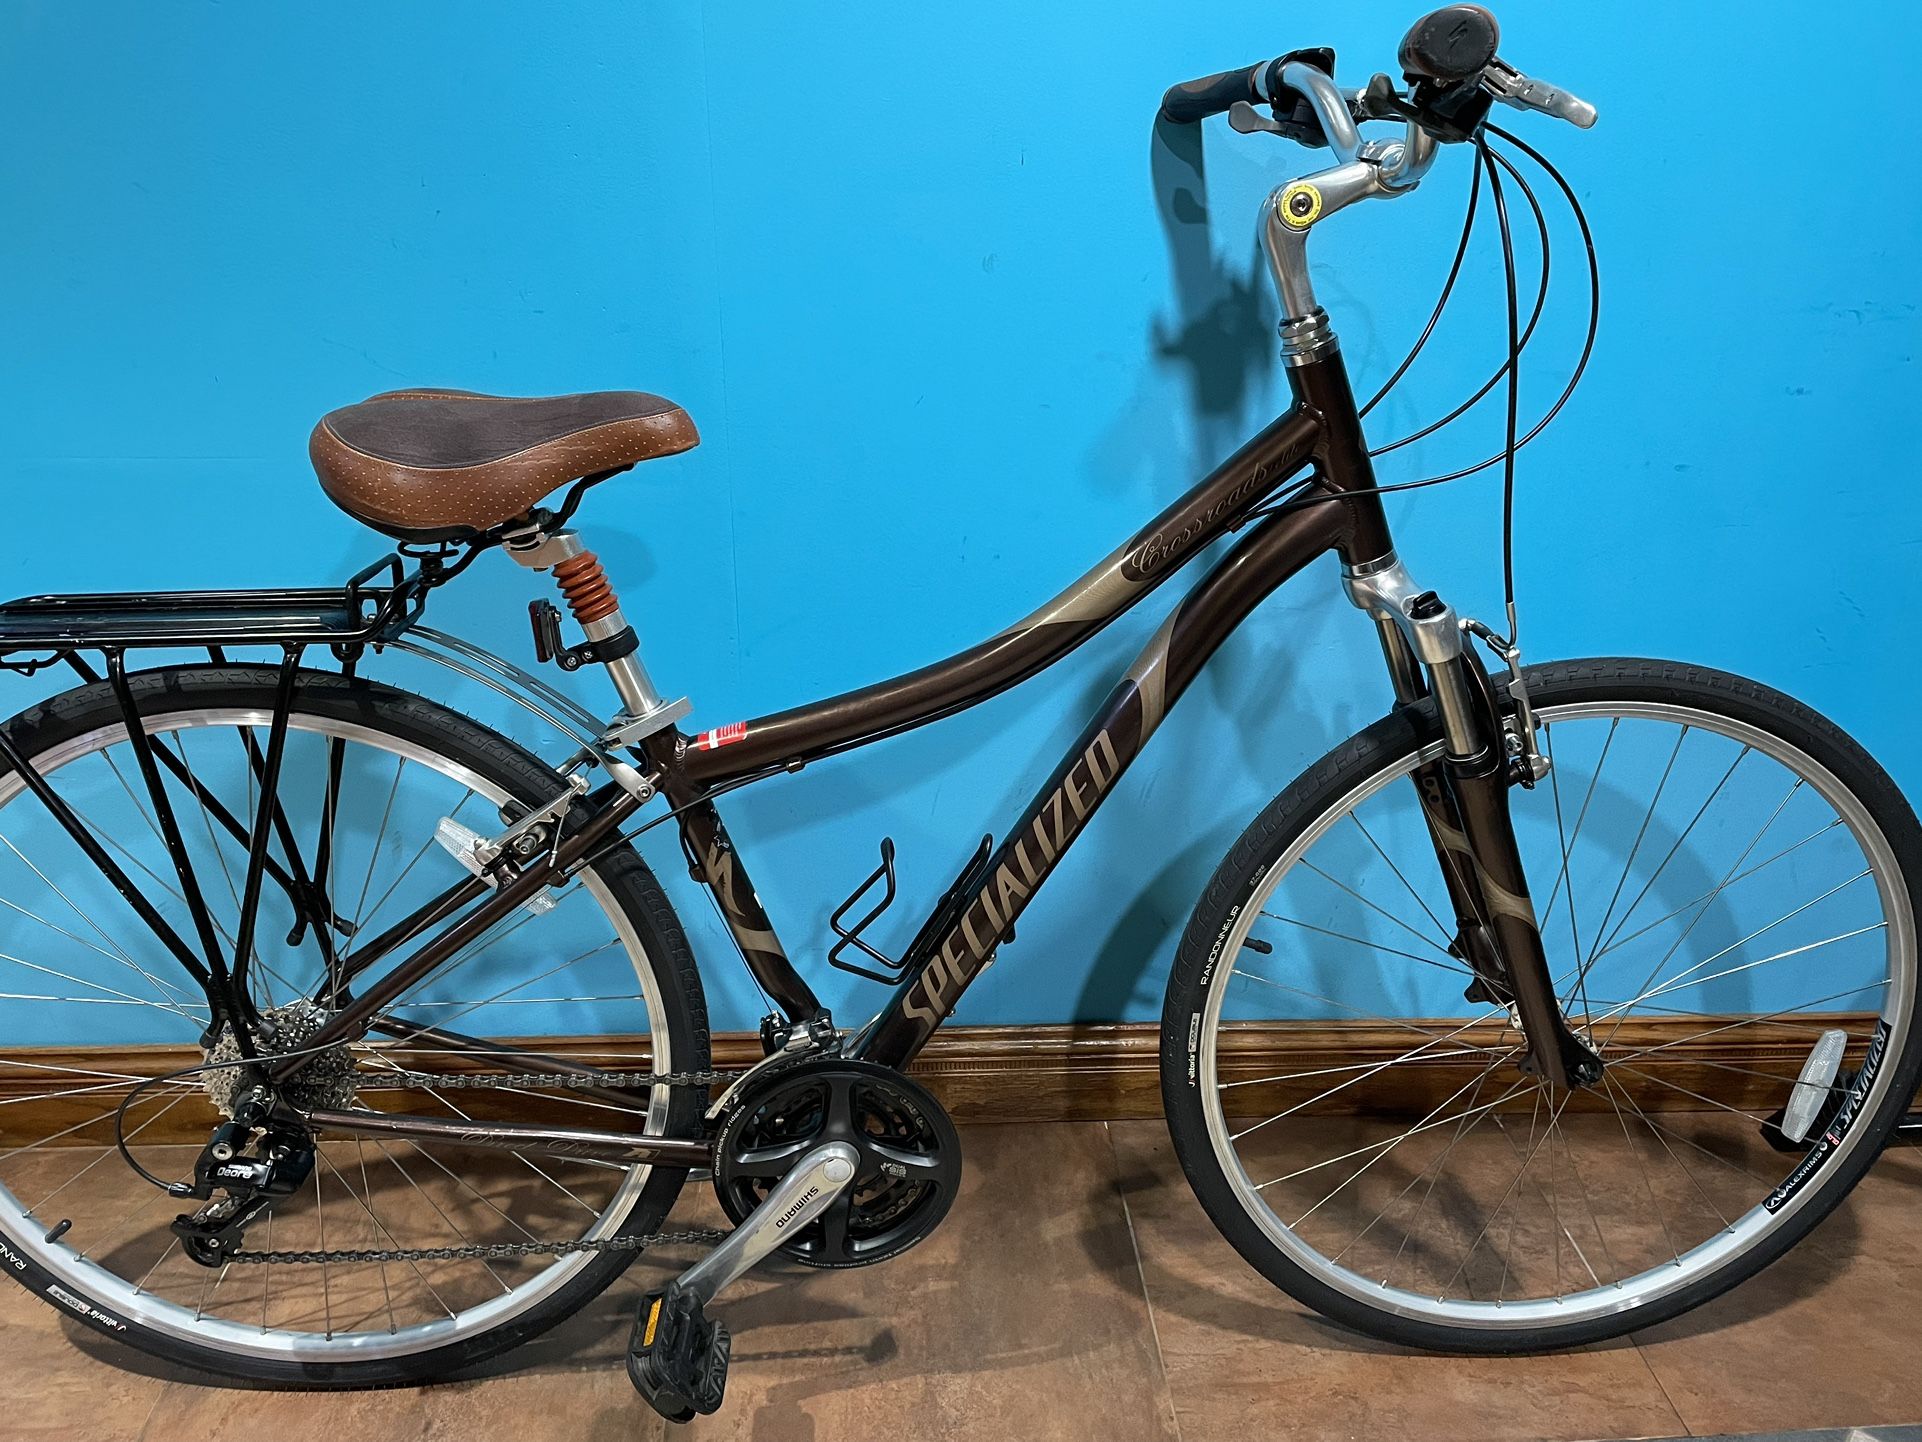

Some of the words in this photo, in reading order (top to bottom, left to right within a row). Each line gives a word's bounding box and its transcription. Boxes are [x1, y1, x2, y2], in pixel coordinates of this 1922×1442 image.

[1131, 462, 1267, 574] Crossroads
[902, 728, 1120, 1030] SPECIALIZED
[1200, 905, 1241, 986] RANDONNEUR
[216, 1166, 253, 1179] Deore
[1785, 1151, 1823, 1193] ALEXRIMS
[775, 1185, 819, 1229] SHIMANO
